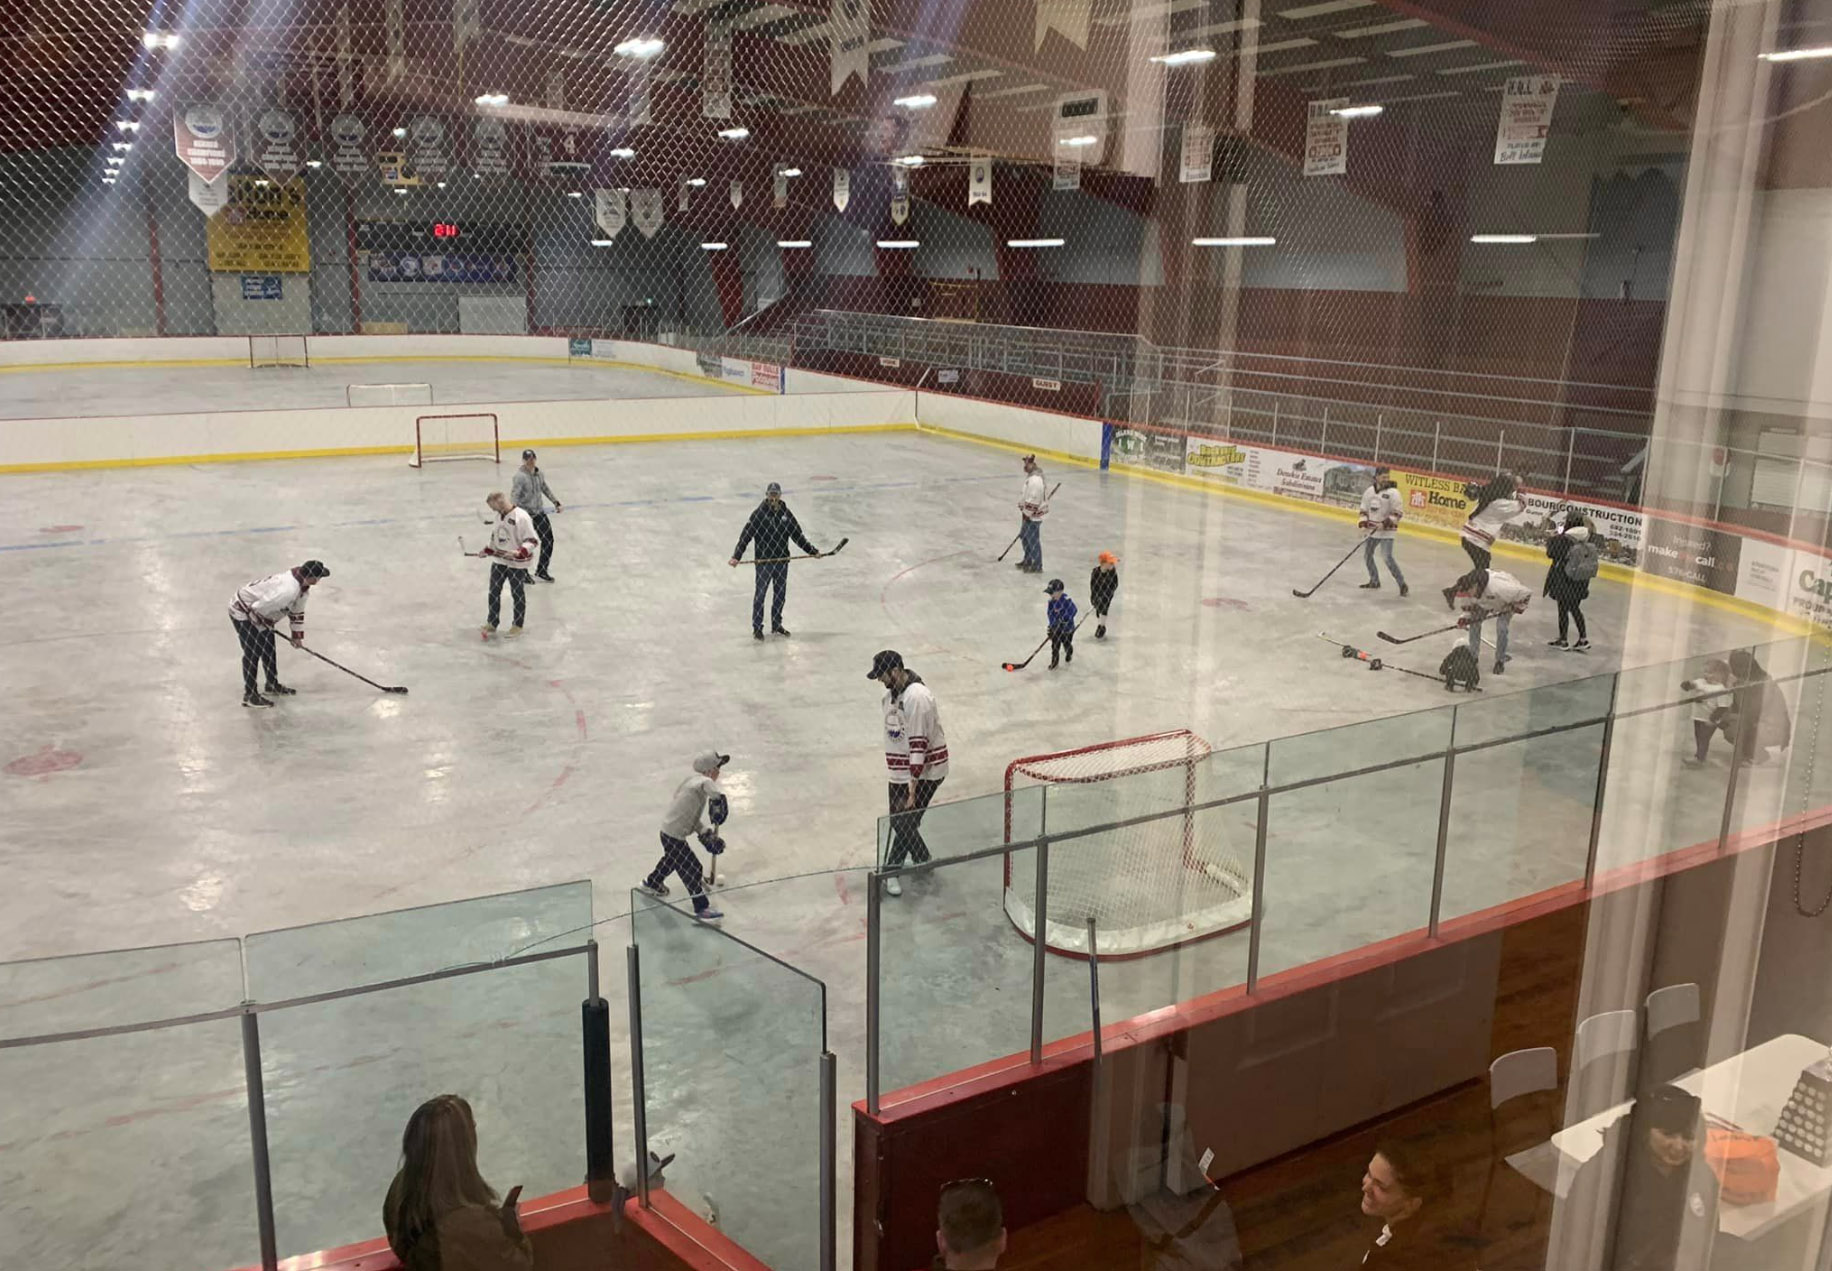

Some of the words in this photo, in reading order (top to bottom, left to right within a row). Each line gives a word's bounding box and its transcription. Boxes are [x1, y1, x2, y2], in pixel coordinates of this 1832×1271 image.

[1405, 473, 1451, 492] WITLESS
[1453, 482, 1467, 494] BA
[1428, 490, 1466, 510] Home
[1560, 503, 1643, 526] CONSTRUCTION
